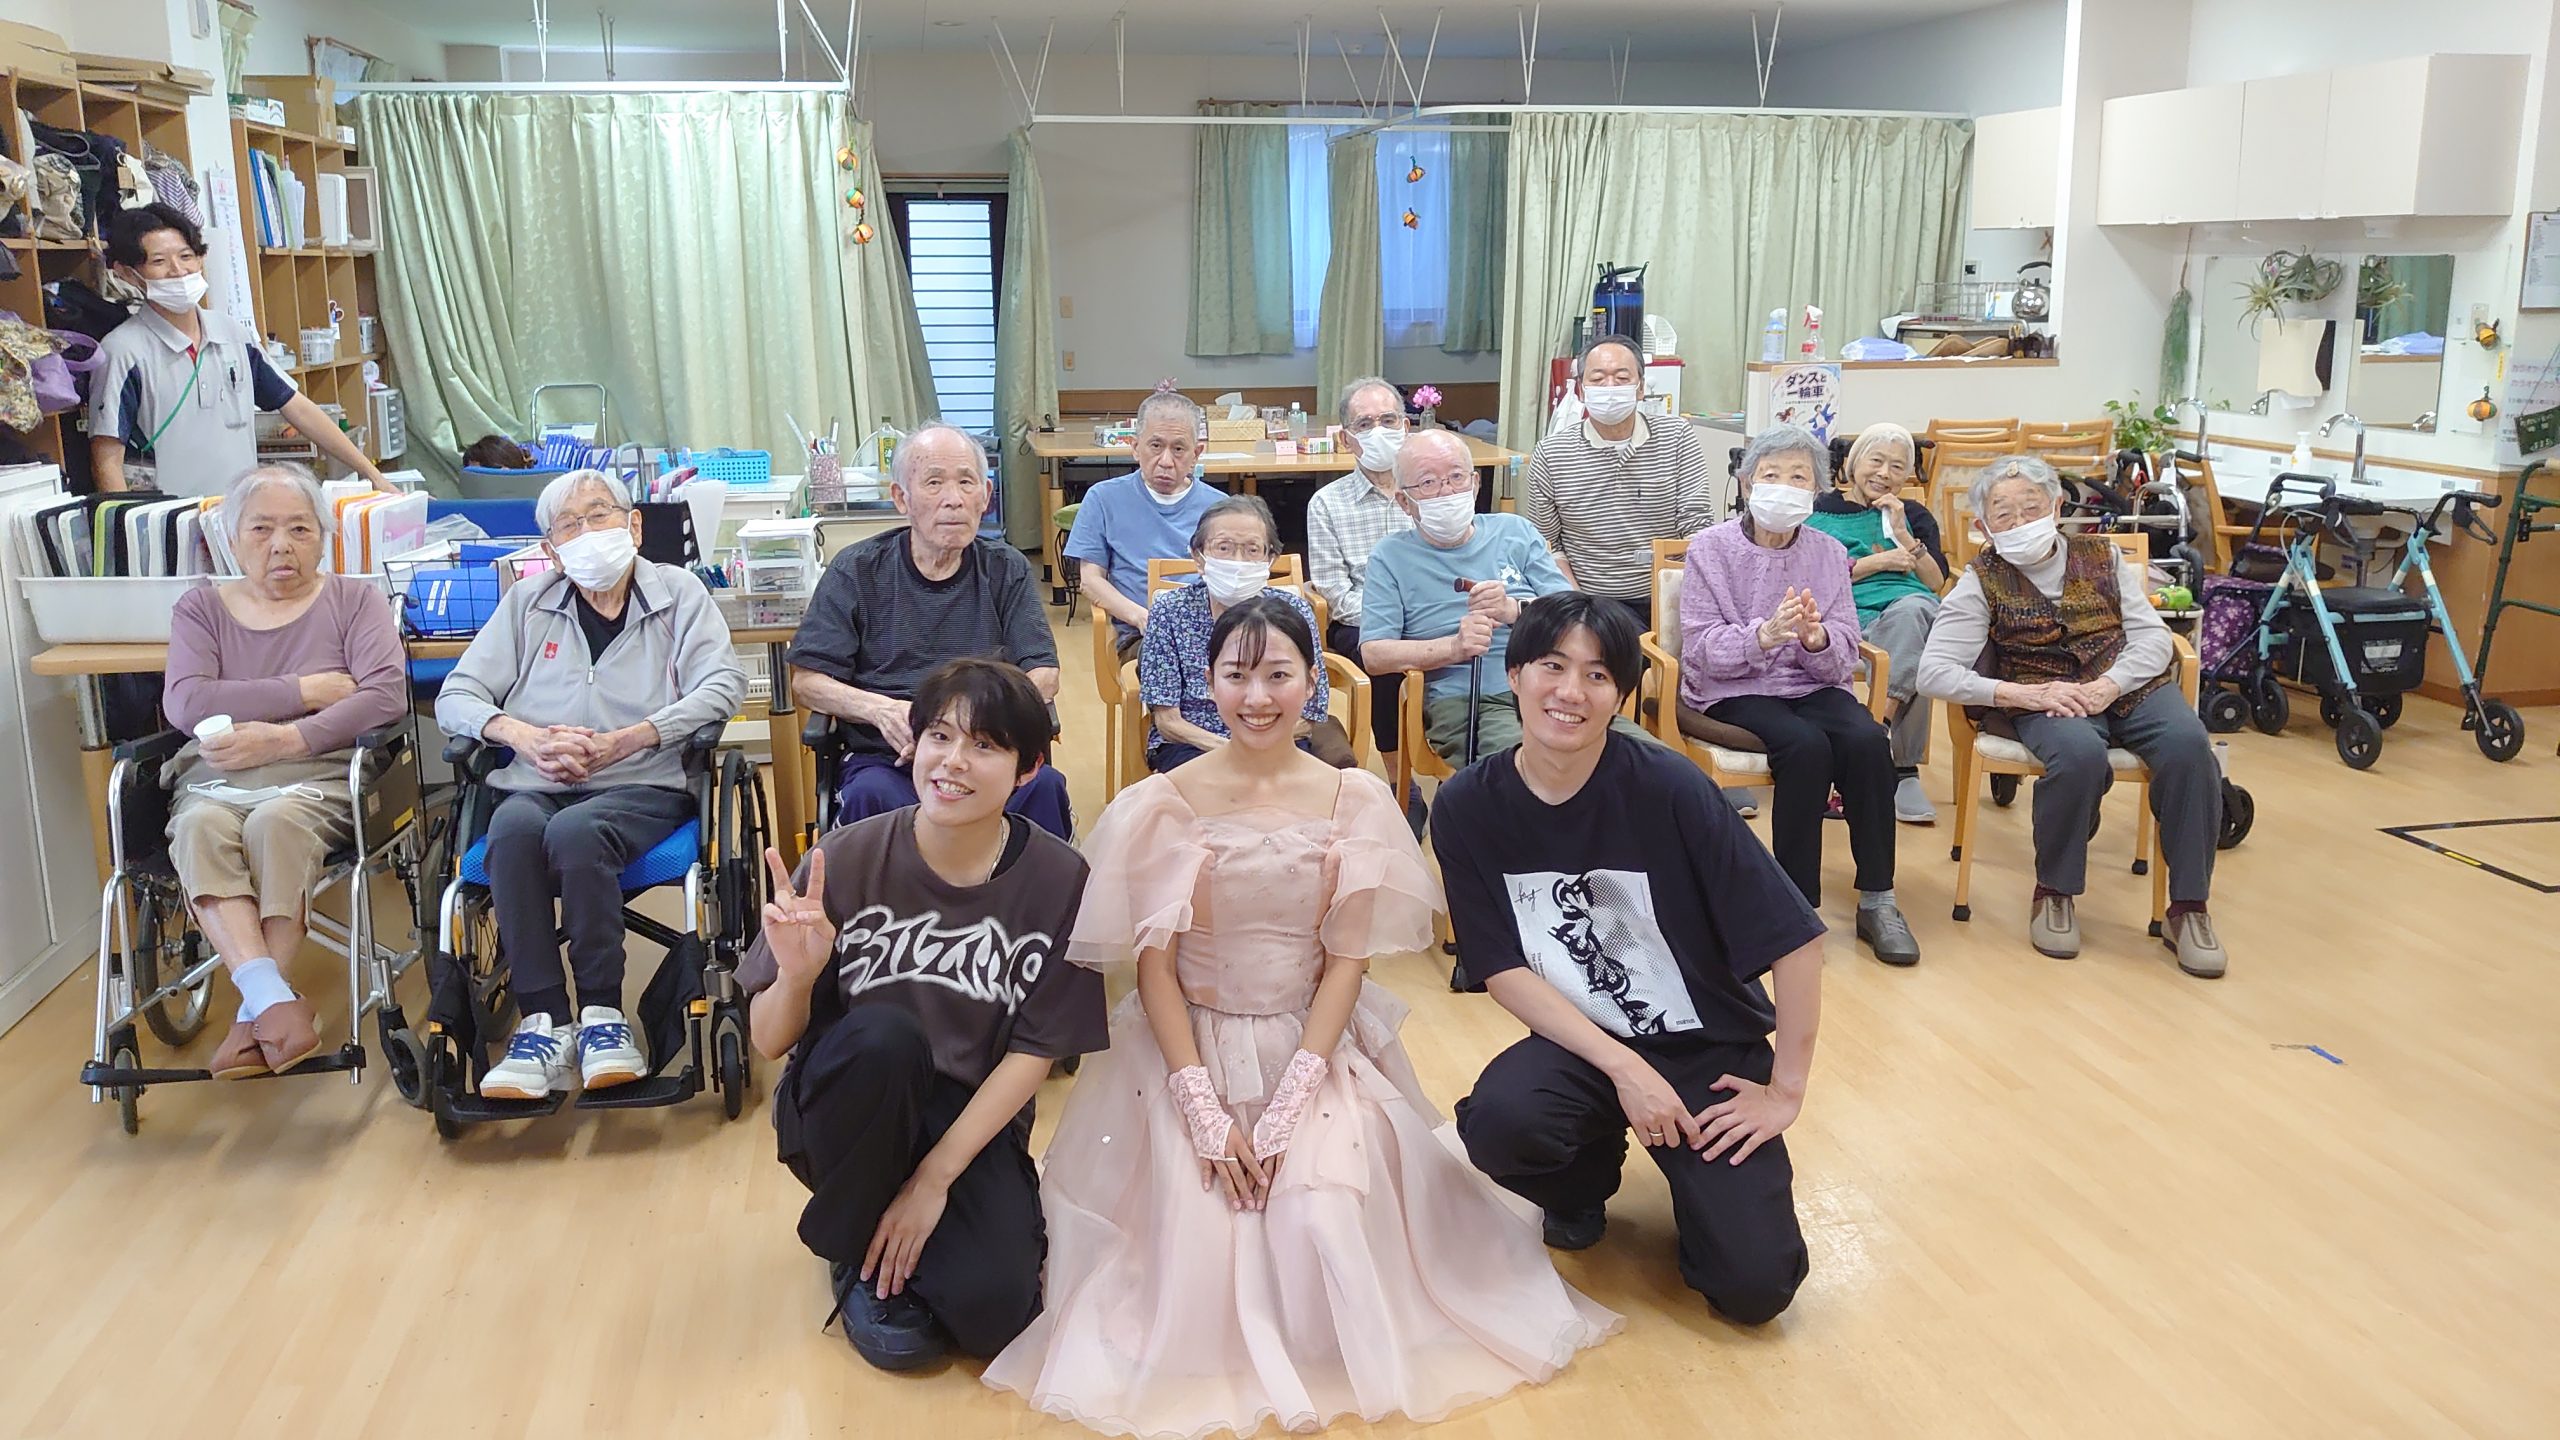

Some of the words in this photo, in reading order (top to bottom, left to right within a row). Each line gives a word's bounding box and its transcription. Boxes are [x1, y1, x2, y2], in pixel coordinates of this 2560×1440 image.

[1786, 372, 1827, 387] ダンスと
[1787, 385, 1824, 398] 一輪車
